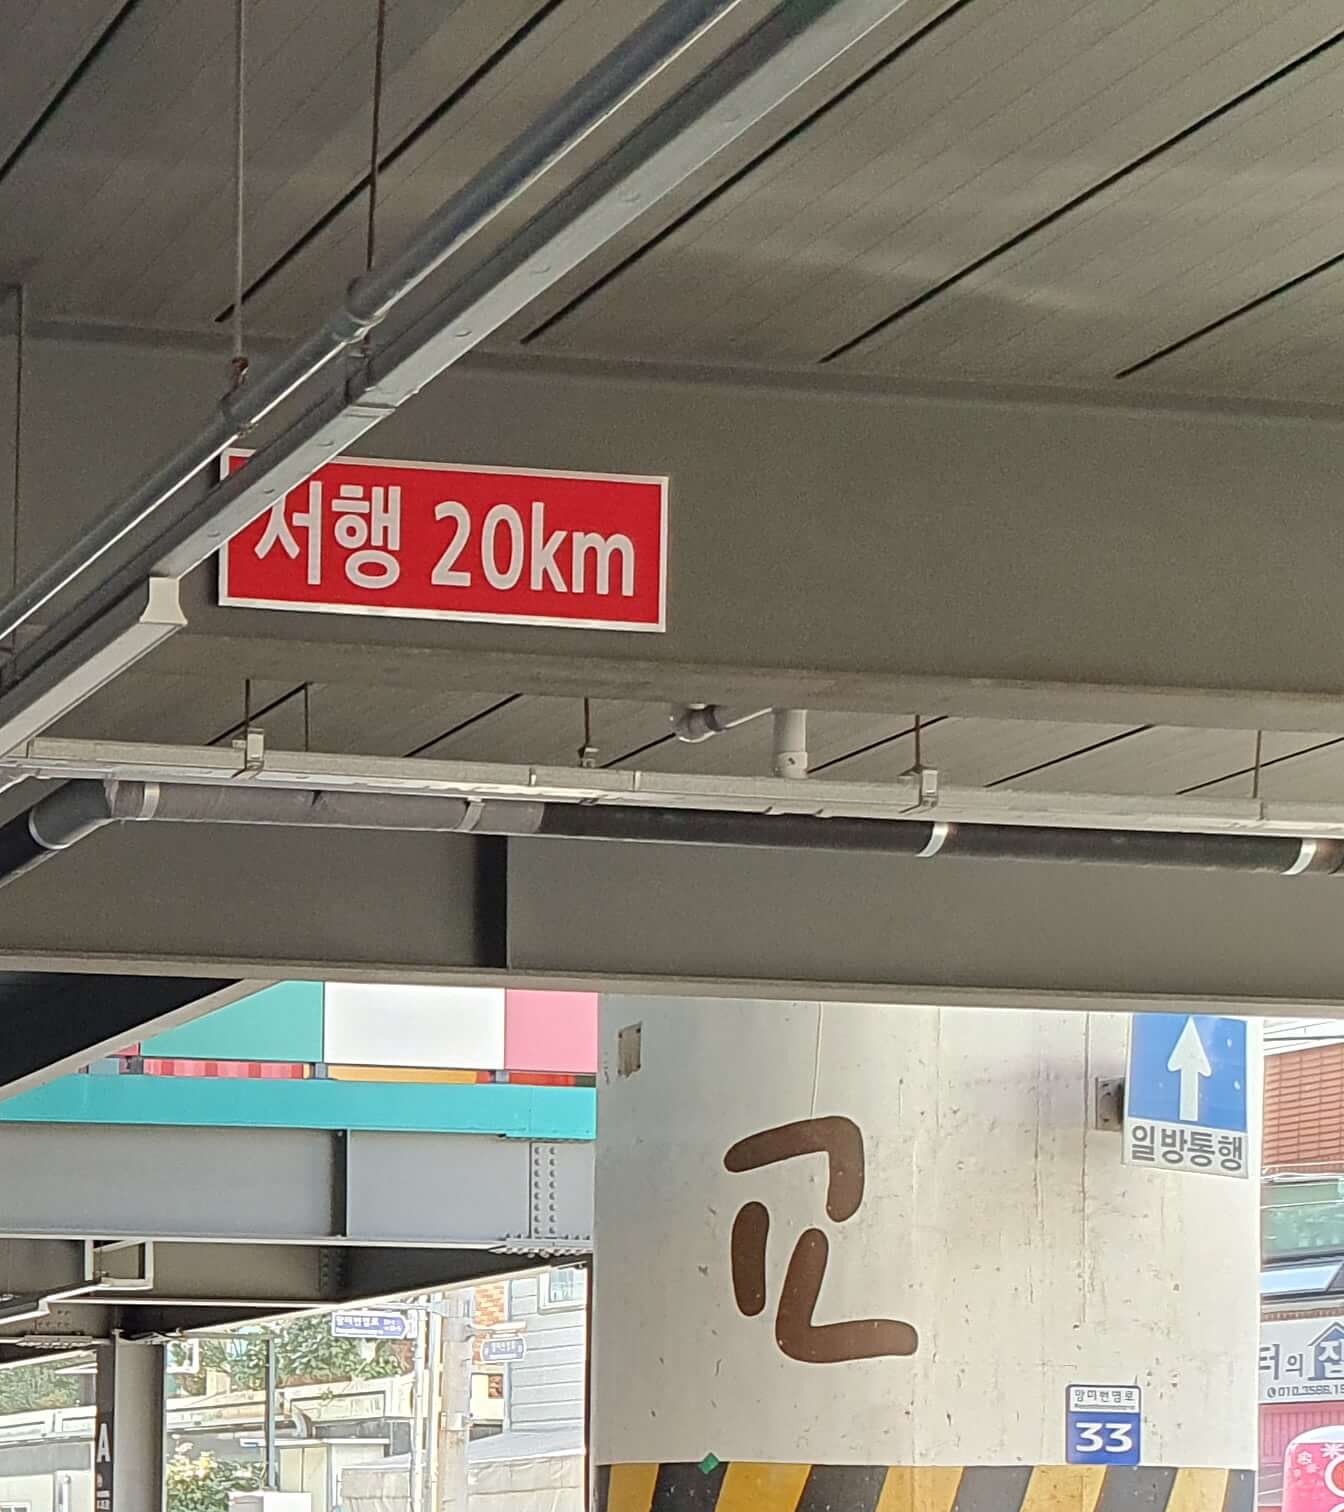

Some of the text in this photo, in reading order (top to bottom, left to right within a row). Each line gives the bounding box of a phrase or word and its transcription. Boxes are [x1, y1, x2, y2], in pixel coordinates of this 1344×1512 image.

[253, 480, 635, 598] 서행 20km
[1131, 1124, 1244, 1172] 일방통행
[96, 1423, 111, 1463] A
[1075, 1421, 1133, 1454] 33
